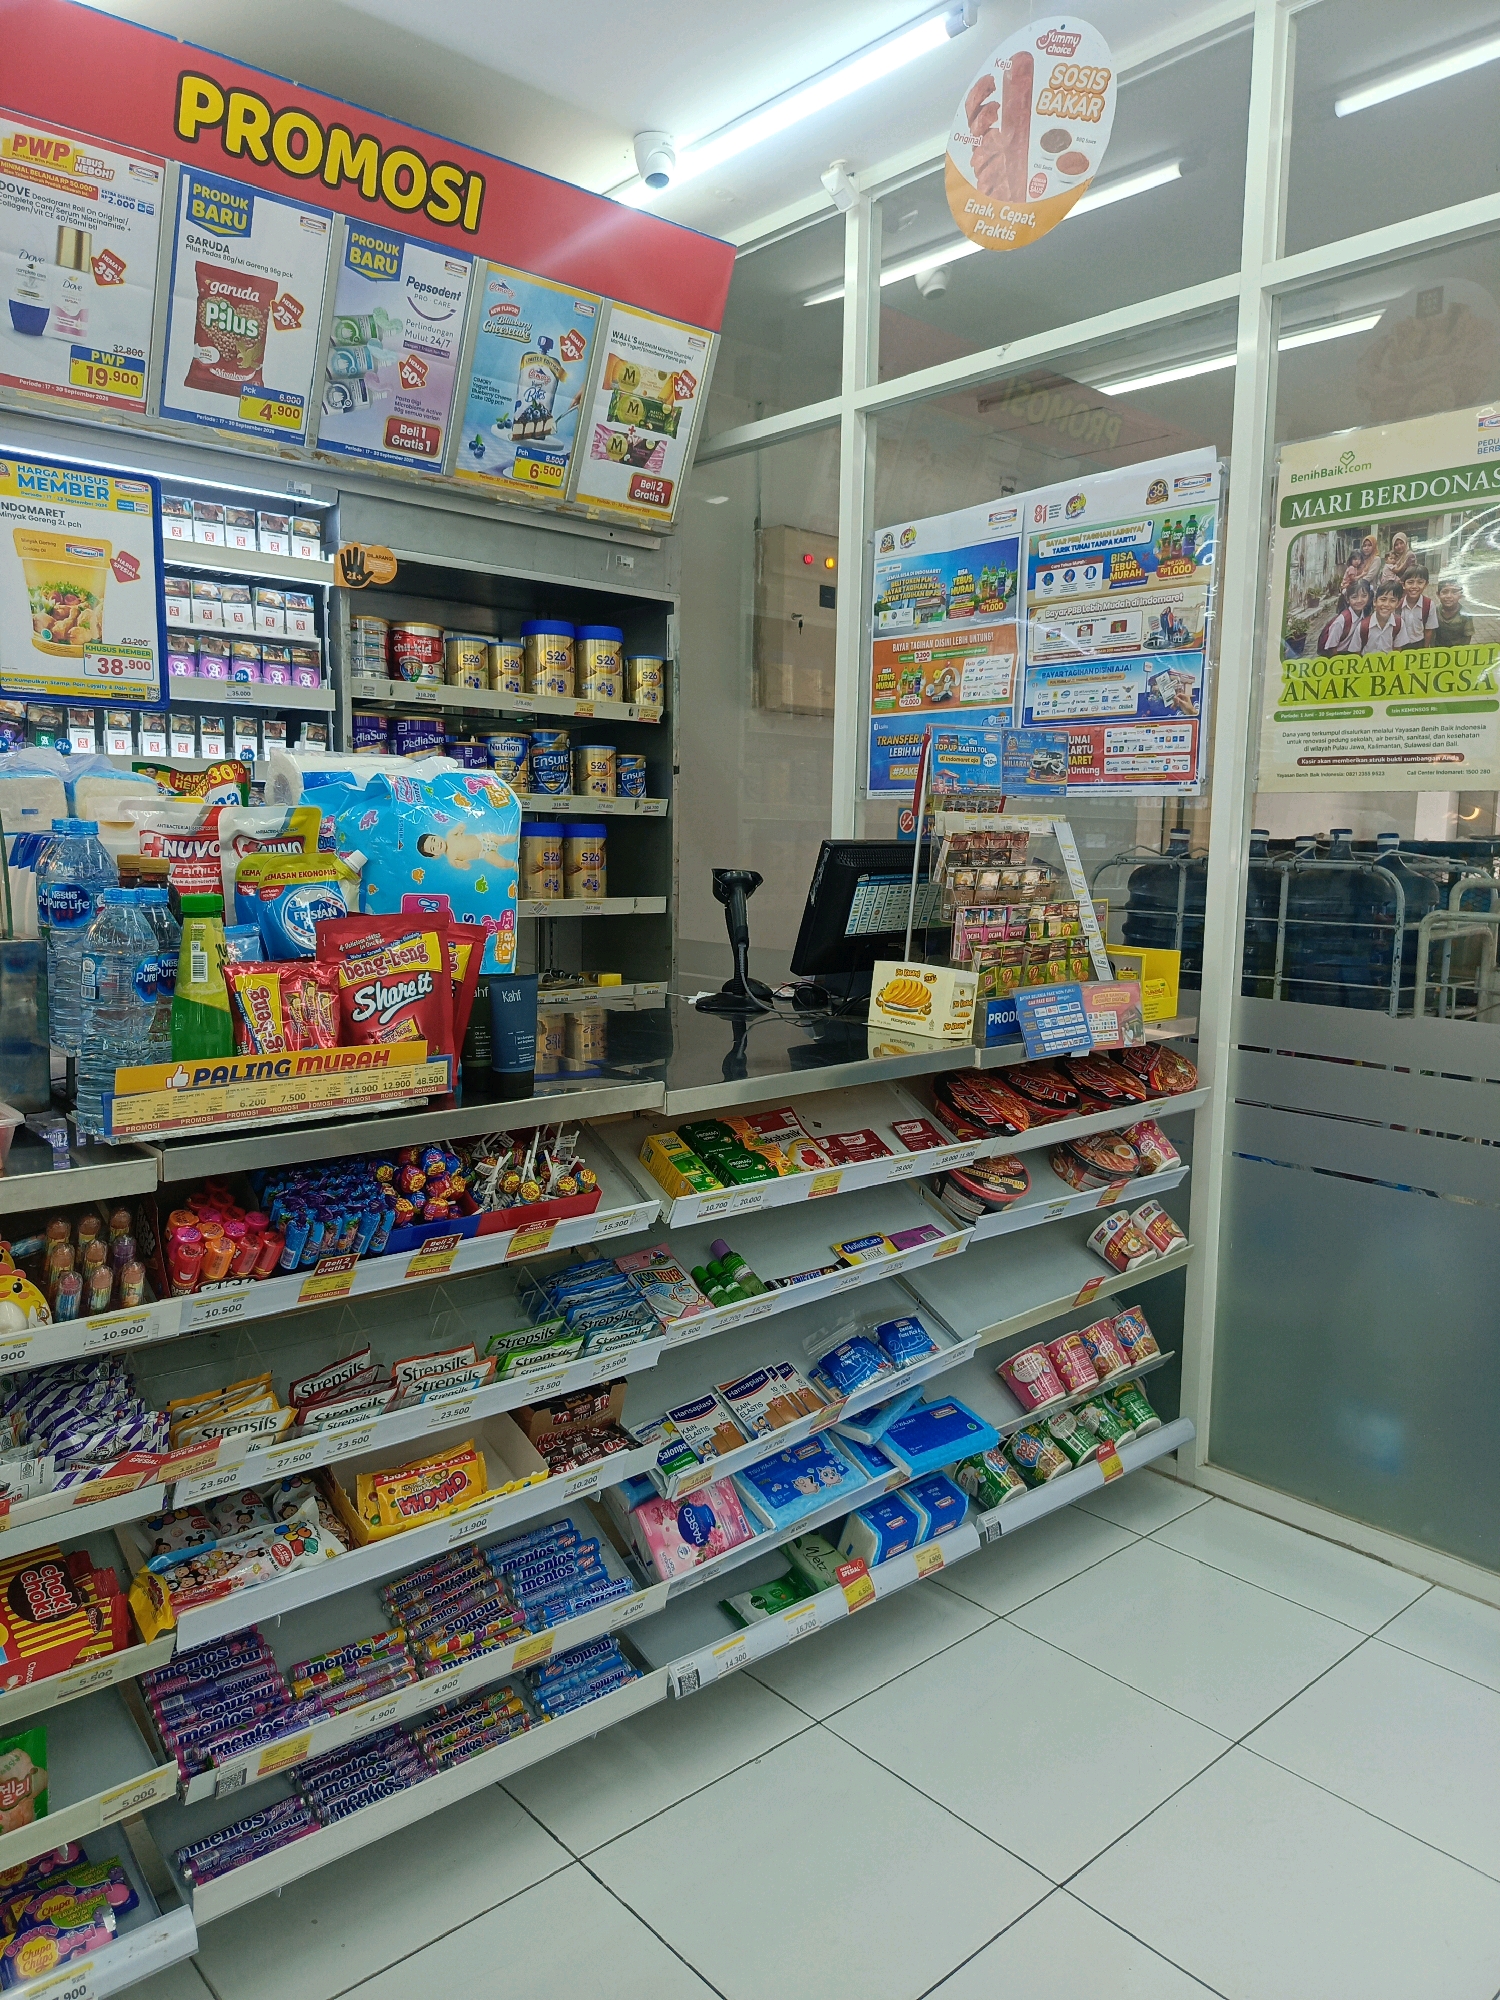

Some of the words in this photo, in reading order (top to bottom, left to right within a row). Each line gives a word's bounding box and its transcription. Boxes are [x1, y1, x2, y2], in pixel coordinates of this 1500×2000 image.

[1047, 30, 1080, 46] Yummy
[994, 58, 1012, 70] Keju
[1051, 66, 1108, 91] SOSIS
[1037, 90, 1103, 118] BAKAR
[13, 134, 71, 162] PWP
[954, 133, 982, 146] Original
[77, 155, 104, 168] TEBUS
[177, 74, 480, 233] PROMOSI
[0, 162, 29, 175] MINIMAL
[30, 169, 59, 183] BELANJA
[74, 163, 115, 180] HEBOH!
[32, 193, 71, 209] Deodorant
[72, 204, 85, 213] Roll
[192, 182, 249, 211] PRODUK
[191, 200, 248, 230] BARU
[964, 199, 995, 219] Enak,
[1000, 206, 1037, 228] Cepat,
[973, 220, 1017, 241] Praktis
[186, 234, 231, 254] GARUDA
[351, 232, 400, 257] PRODUK
[350, 247, 399, 275] BARU
[95, 261, 121, 284] 35%
[62, 278, 83, 292] Dove
[209, 280, 260, 303] garuda
[405, 275, 462, 302] Pepsodent
[273, 305, 298, 328] 25%
[406, 318, 454, 338] Perlindungan
[482, 319, 532, 343] Cheesecake
[404, 328, 428, 344] Mulut
[430, 335, 451, 349] 24/7
[612, 330, 639, 344] WALL'S
[91, 350, 126, 367] PWP
[561, 340, 580, 360] 20%
[86, 365, 139, 387] 19.900
[401, 367, 422, 386] 50%
[259, 403, 300, 421] 4.900
[399, 424, 419, 438] Beli
[391, 435, 424, 452] Gratis
[17, 465, 59, 479] HARGA
[62, 473, 109, 486] KHUSUS
[529, 463, 562, 480] 6.500
[18, 475, 110, 502] MEMBER
[640, 478, 657, 490] Beli
[634, 488, 660, 502] Gratis
[1290, 492, 1352, 520] MARI
[1359, 469, 1500, 509] BERDONAS
[0, 503, 65, 519] NDOMARET
[28, 515, 56, 528] Goreng
[67, 521, 82, 530] pch
[1092, 539, 1113, 549] TANPA
[1114, 535, 1137, 546] KARTU
[117, 556, 136, 572] HARGA
[1111, 551, 1134, 561] BISA
[113, 561, 135, 579] SPESIAL
[1110, 560, 1137, 571] TEBUS
[1109, 569, 1142, 582] MURAH
[1045, 606, 1067, 619] Bayar
[1082, 602, 1102, 615] Lebih
[1103, 599, 1130, 612] Mudah
[1140, 592, 1183, 607] Indomaret
[85, 644, 117, 655] KHUSUS
[118, 648, 151, 657] MEMBER
[97, 657, 151, 676] 38.900
[1286, 653, 1396, 680] PROGRAM
[1404, 646, 1494, 672] PEDULI
[1282, 676, 1361, 702] ANAK
[1369, 667, 1494, 698] BANGSA
[403, 734, 445, 750] PediaSure
[489, 742, 520, 752] Nutrilon
[877, 734, 919, 746] TRANSFER
[889, 746, 911, 758] LEBIH
[958, 745, 977, 753] KARTU
[532, 752, 570, 769] Ensure
[1332, 756, 1367, 764] memberikan
[208, 763, 245, 786] 30%
[621, 769, 646, 781] Ensure
[1071, 766, 1100, 776] Untung
[163, 840, 220, 858] NUVO
[175, 867, 221, 875] FAMILY
[264, 871, 296, 882] KEMASAN
[298, 868, 337, 878] EKONOMIS
[50, 900, 68, 909] Pure
[69, 899, 90, 913] Life
[339, 942, 430, 979] beng-beng
[502, 990, 522, 1003] Kahf
[349, 1083, 379, 1095] 14.900
[383, 1079, 411, 1090] 12.900
[416, 1075, 444, 1086] 48.500
[240, 1098, 267, 1108] 6.200
[281, 1092, 307, 1103] 7.500
[126, 1123, 160, 1133] PROMOSI
[181, 1115, 214, 1125] PROMOSI
[894, 1163, 914, 1174] 28.000
[705, 1201, 729, 1213] 10.700
[739, 1194, 763, 1206] 20.000
[602, 1219, 629, 1232] 15.300
[660, 1266, 685, 1283] FEVER
[205, 1303, 243, 1320] 10.500
[103, 1324, 144, 1342] 10.900
[497, 1326, 557, 1351] Strepsils
[680, 1325, 702, 1337] 8.500
[601, 1357, 628, 1372] 23.500
[300, 1361, 366, 1399] Strepsils
[534, 1380, 562, 1393] 23.500
[727, 1373, 766, 1398] Hansaplast
[673, 1398, 715, 1420] Hansaplast
[680, 1424, 699, 1436] KAIN
[686, 1425, 711, 1442] ELASTIS
[277, 1451, 313, 1468] 27.500
[657, 1443, 687, 1461] Salonpa
[200, 1473, 237, 1490] 23.500
[571, 1475, 599, 1491] 10.200
[457, 1519, 488, 1536] 11.900
[687, 1507, 706, 1545] PASEO
[502, 1544, 556, 1574] mentos
[394, 1568, 434, 1595] mentos
[622, 1602, 645, 1617] 4.900
[795, 1618, 817, 1635] 16.700
[154, 1647, 230, 1683] mentos
[305, 1642, 373, 1676] mentos
[724, 1652, 748, 1670] 14.300
[78, 1668, 113, 1687] 5.500
[433, 1678, 459, 1695] 4.900
[177, 1707, 254, 1743] mentos
[210, 1717, 286, 1754] mentos
[121, 1787, 155, 1809] 5.000
[188, 1813, 266, 1858] mentos
[22, 1943, 53, 1965] Chupa
[22, 1951, 54, 1974] Chups
